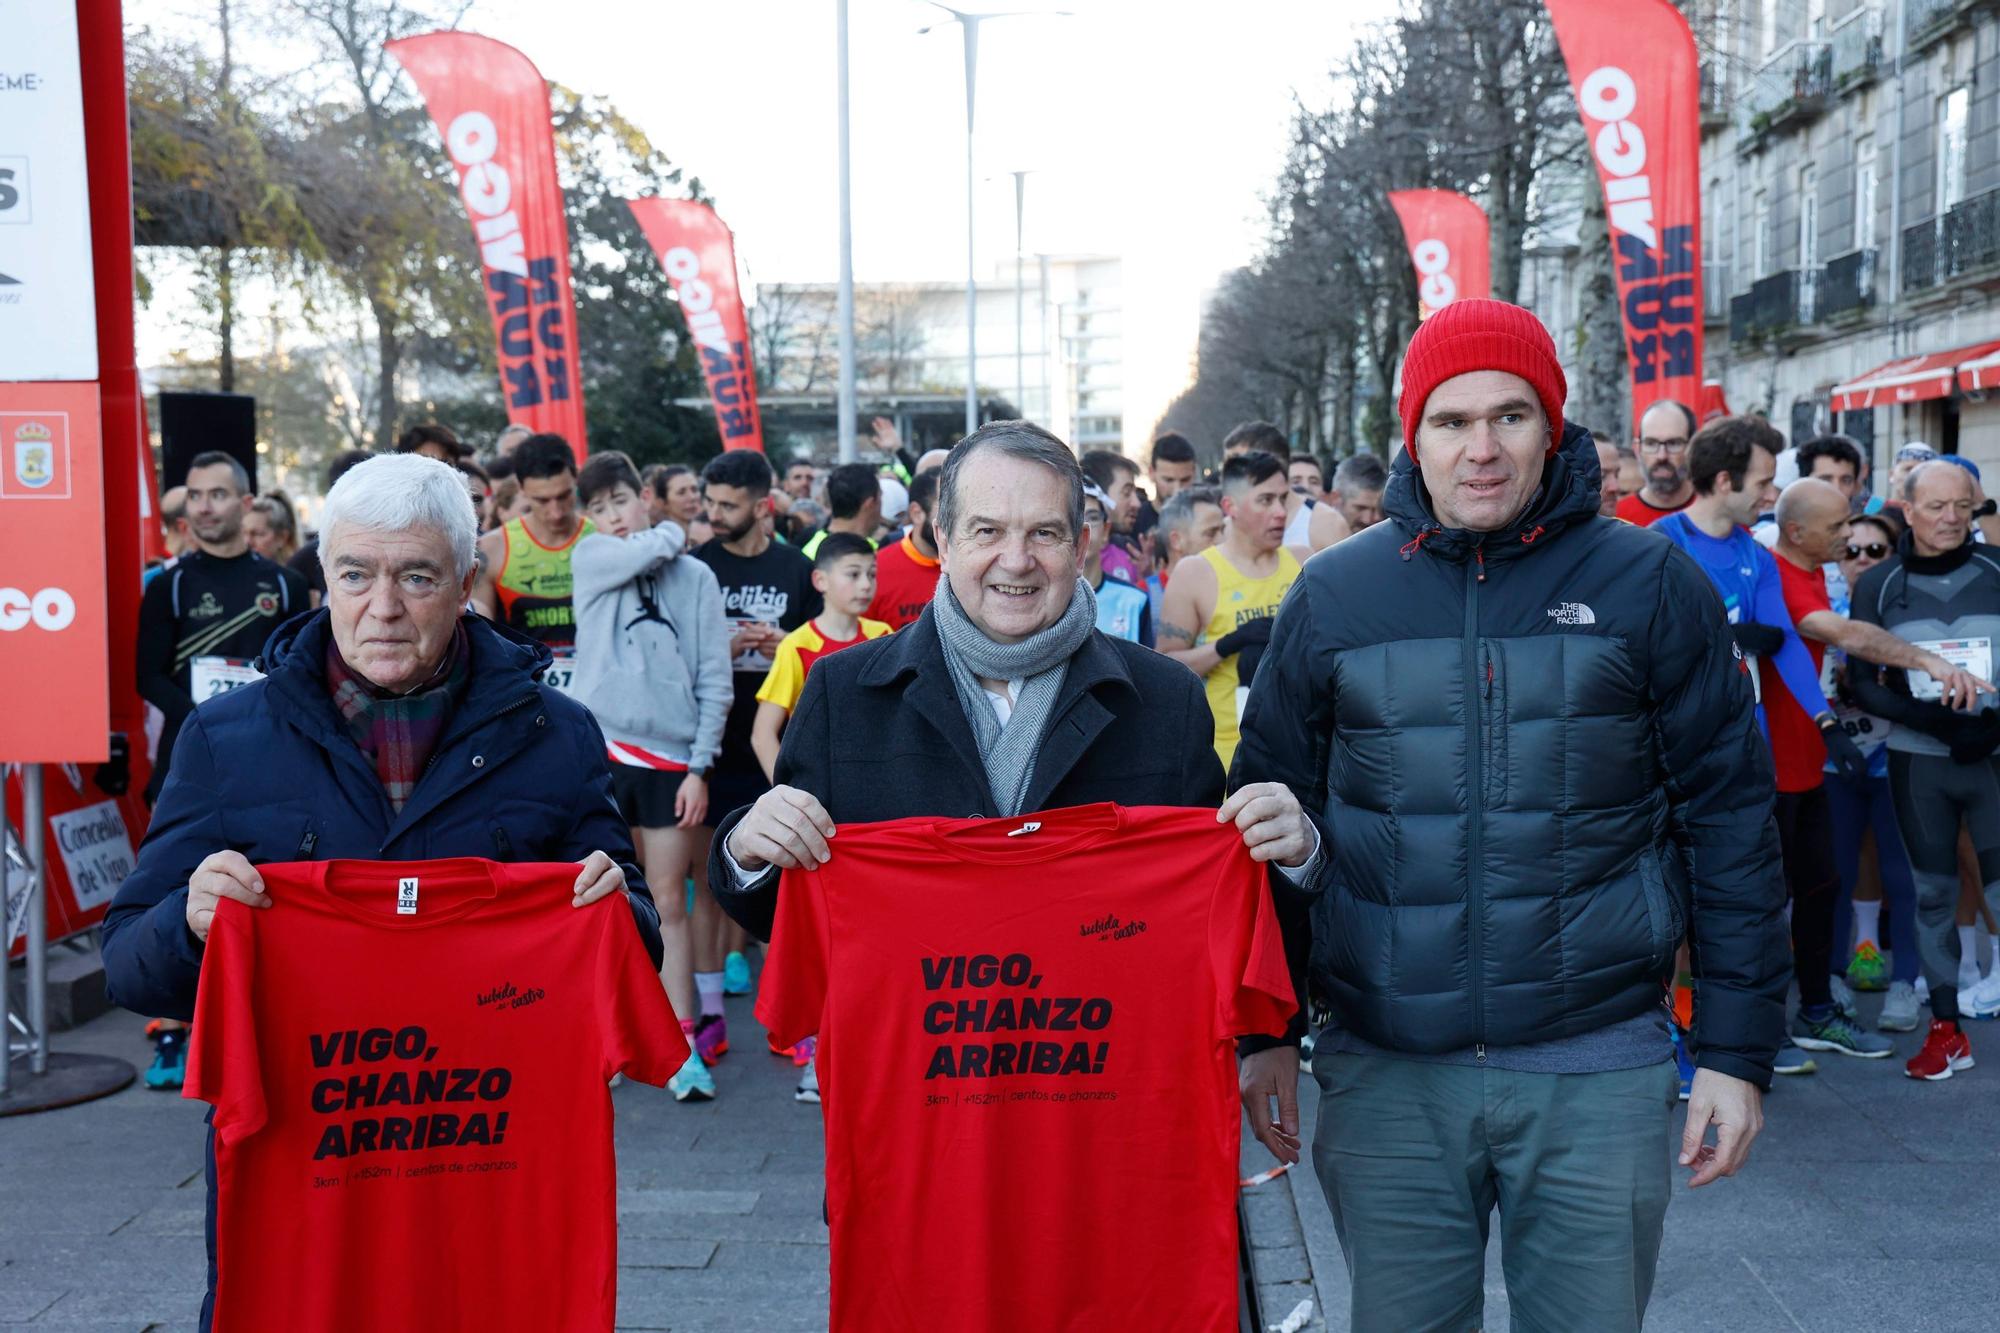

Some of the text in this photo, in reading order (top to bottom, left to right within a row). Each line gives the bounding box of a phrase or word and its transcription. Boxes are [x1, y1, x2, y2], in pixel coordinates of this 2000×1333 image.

[1547, 609, 1579, 617] NORTH
[1561, 602, 1578, 610] THE
[1556, 617, 1581, 625] FACE
[1080, 913, 1119, 936] subida
[1114, 920, 1147, 941] castro
[921, 953, 1043, 991] VIGO,
[512, 987, 545, 1009] castro
[923, 997, 1113, 1035] CHANZO
[309, 1025, 439, 1068] VIGO,
[924, 1041, 1110, 1081] ARRIBA!
[311, 1068, 512, 1114] CHANZO
[1051, 1092, 1067, 1102] de
[313, 1112, 509, 1161] ARRIBA!
[313, 1176, 339, 1189] 3km
[405, 1162, 446, 1178] centos
[448, 1162, 464, 1173] de
